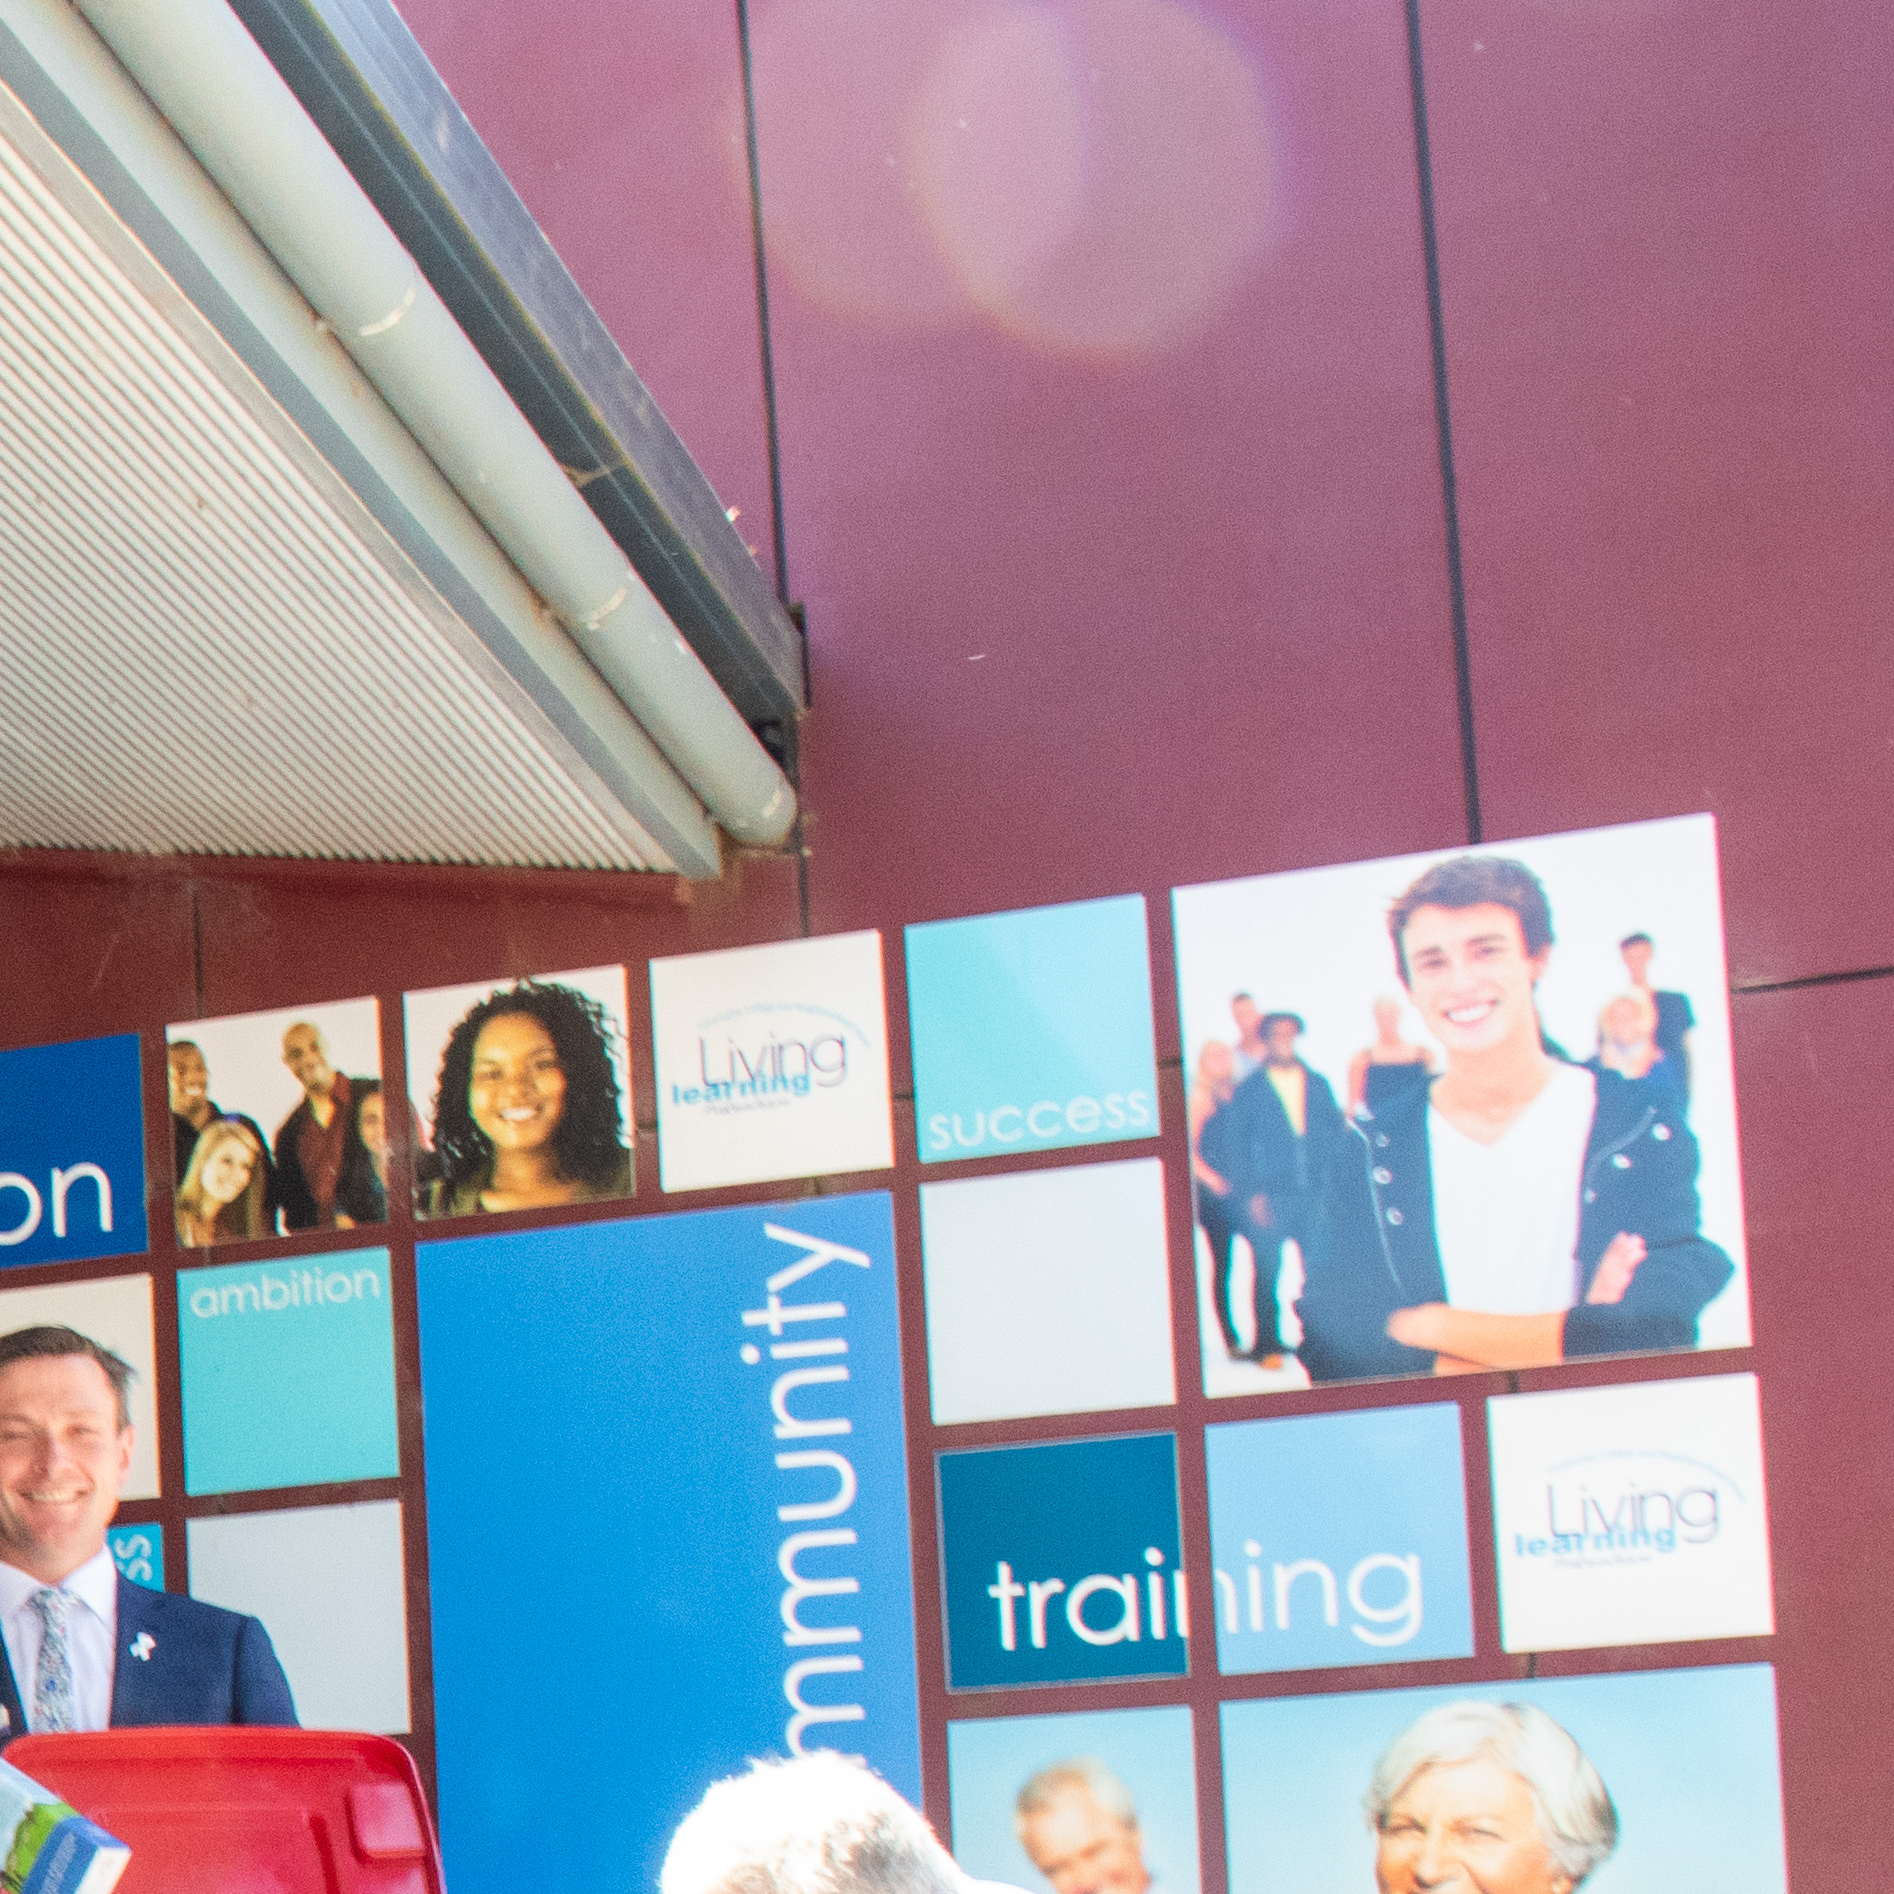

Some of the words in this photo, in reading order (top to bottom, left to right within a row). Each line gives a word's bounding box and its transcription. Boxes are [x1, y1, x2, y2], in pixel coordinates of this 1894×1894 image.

[697, 1031, 848, 1089] Living
[928, 1088, 1151, 1151] success
[189, 1265, 381, 1319] ambition
[741, 1222, 872, 1766] mmunity
[1546, 1479, 1722, 1545] Living
[988, 1537, 1424, 1649] training
